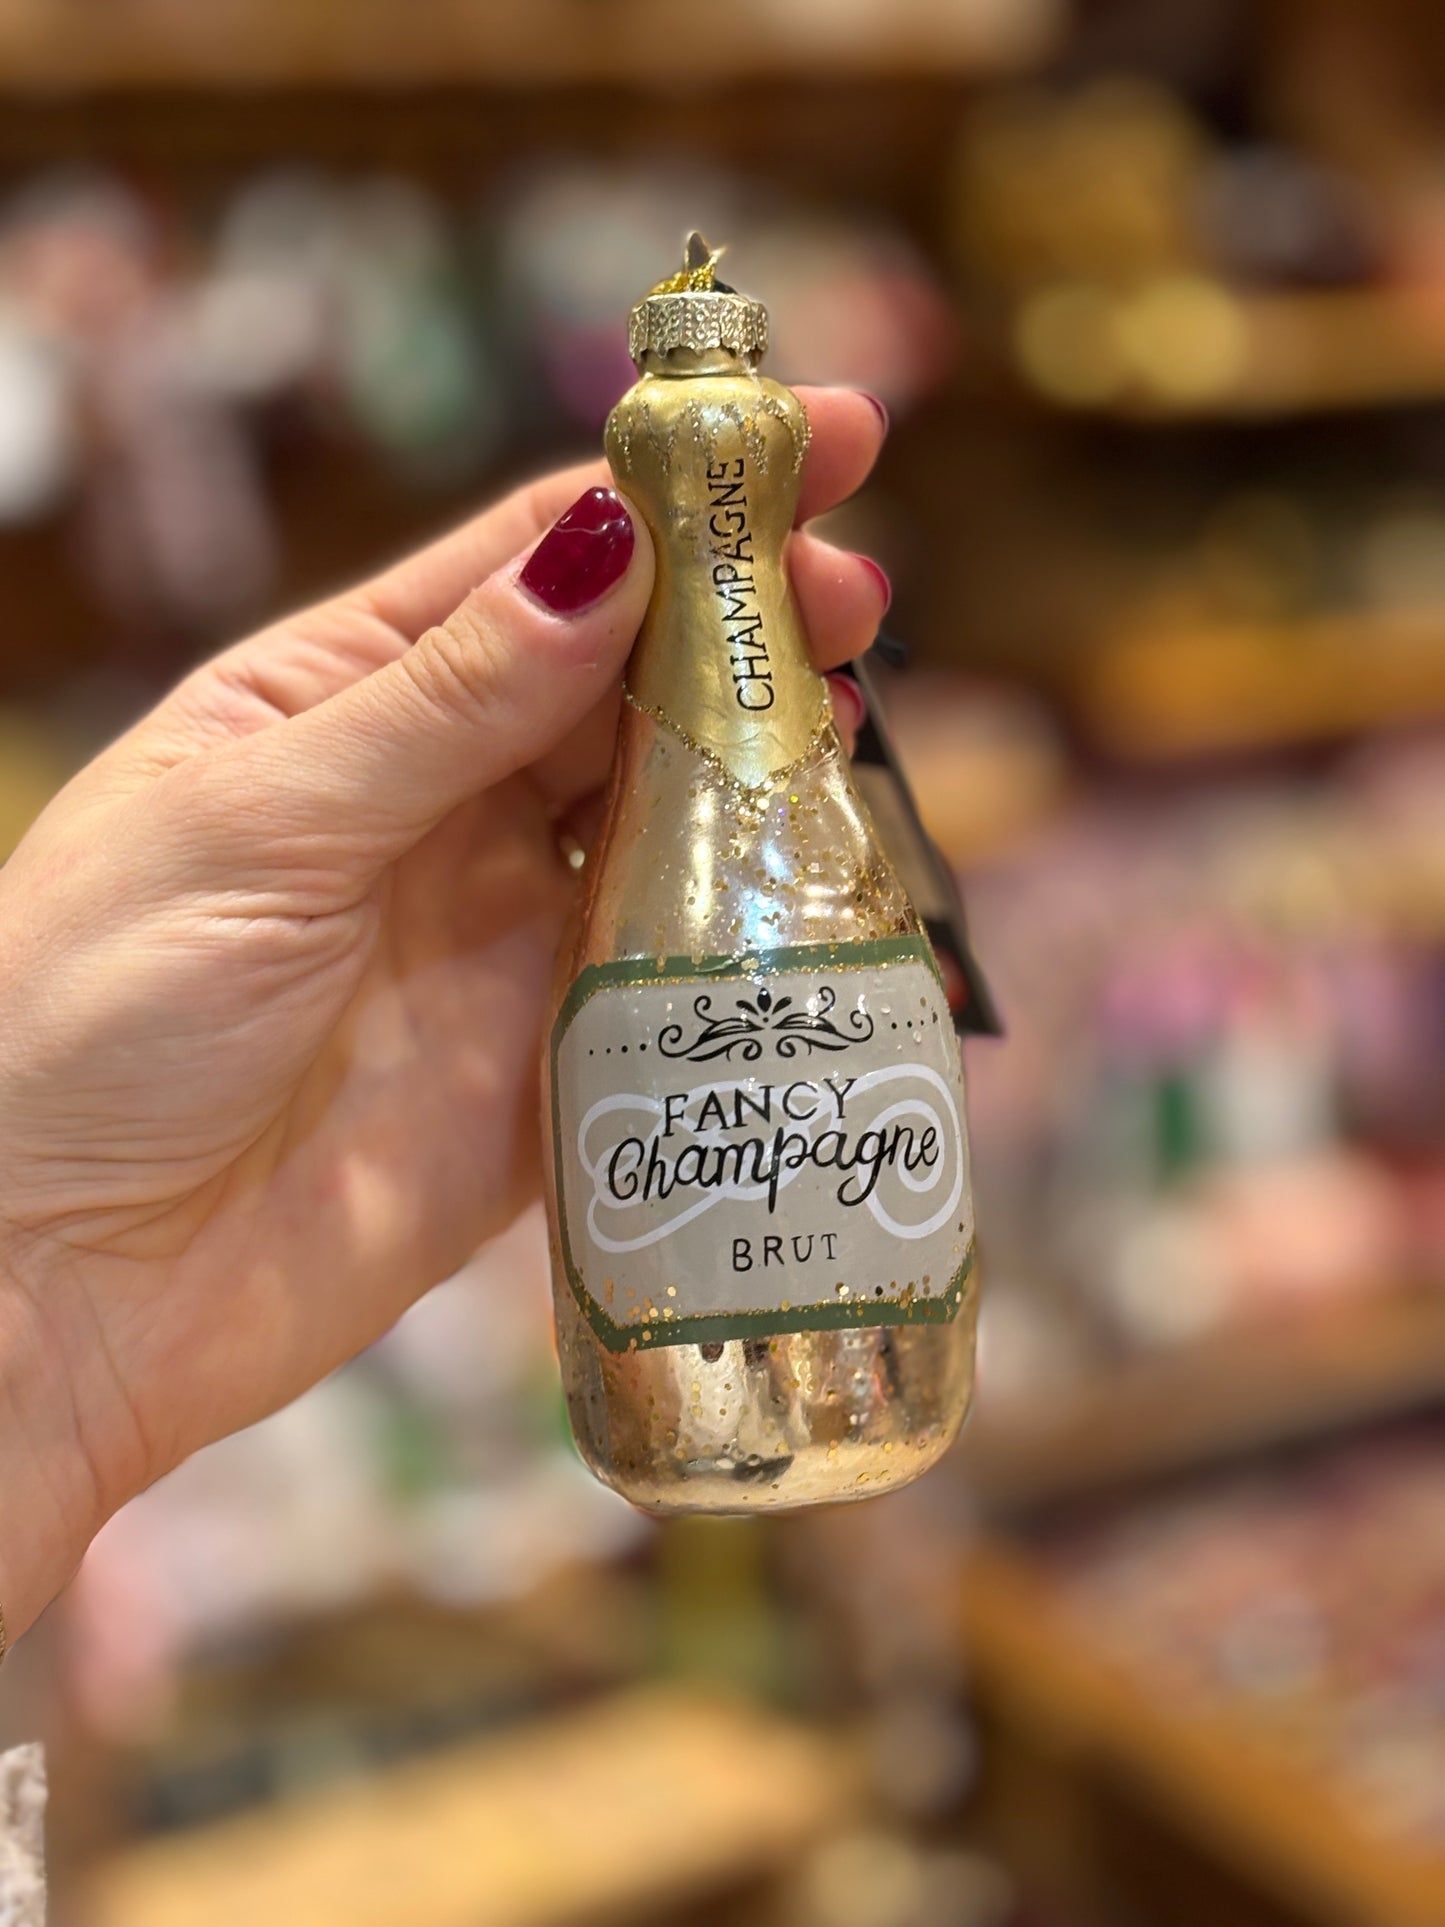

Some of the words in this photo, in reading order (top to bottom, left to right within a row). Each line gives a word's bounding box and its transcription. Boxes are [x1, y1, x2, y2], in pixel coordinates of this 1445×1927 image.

[706, 458, 774, 711] CHAMPAGNE
[662, 1077, 857, 1137] FANCY
[608, 1125, 940, 1214] Champagne
[731, 1233, 838, 1272] BRUT
